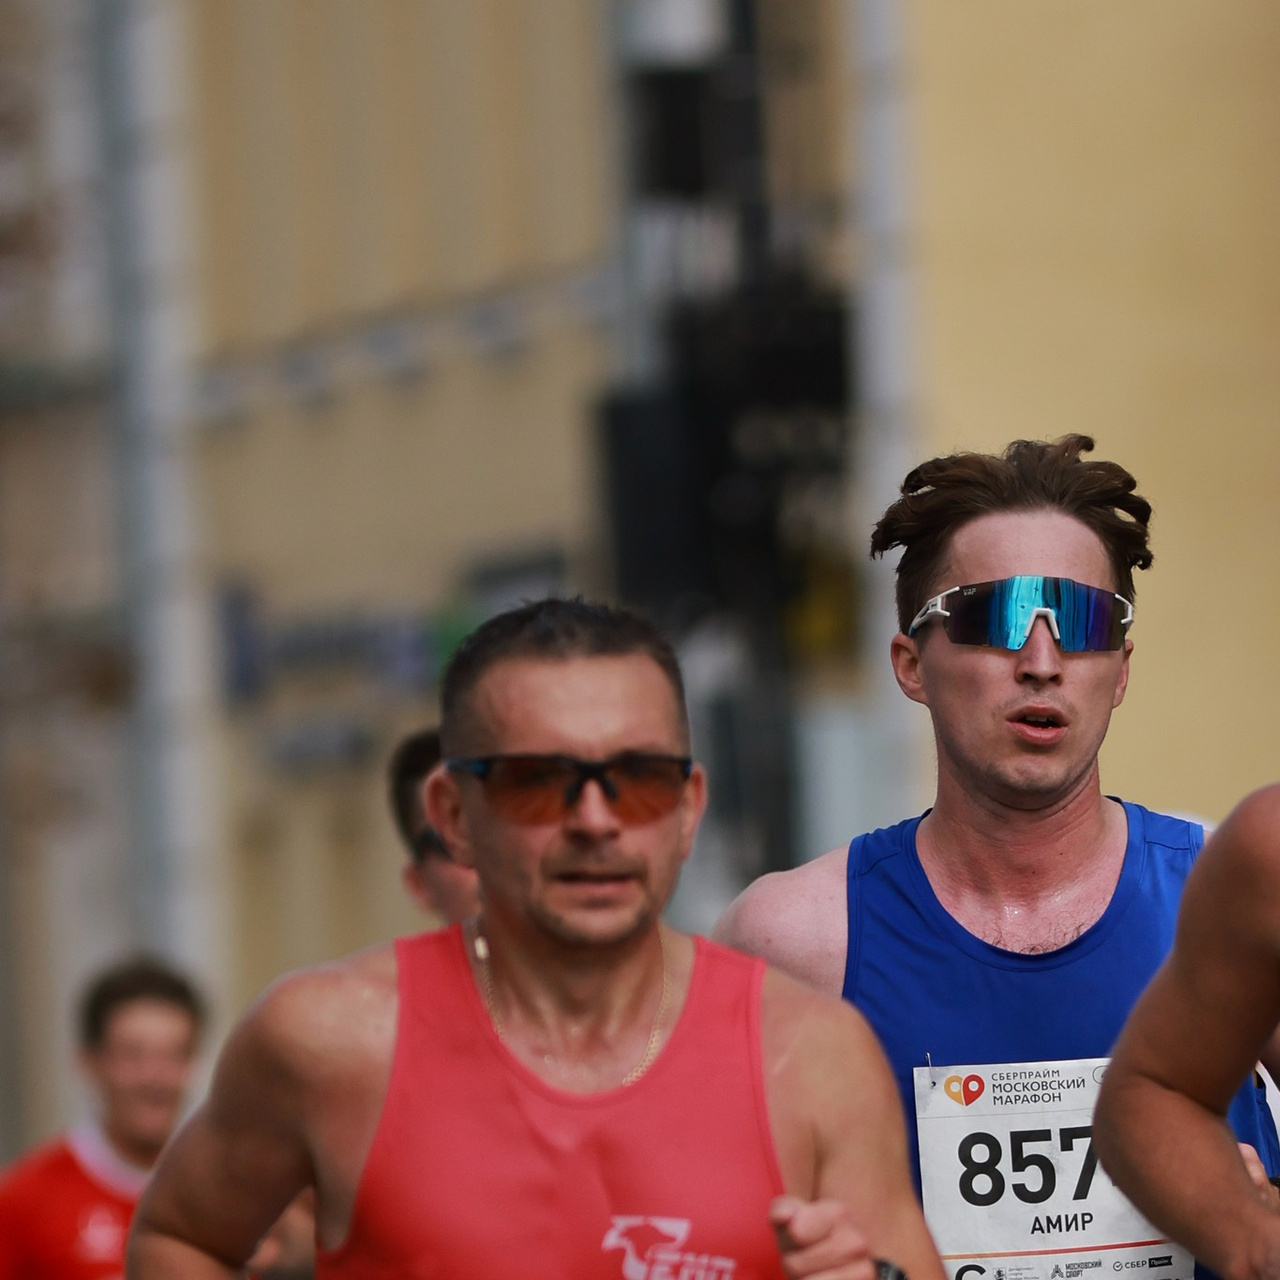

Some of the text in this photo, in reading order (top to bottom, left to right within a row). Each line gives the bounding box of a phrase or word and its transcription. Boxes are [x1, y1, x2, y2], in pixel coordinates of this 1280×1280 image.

[991, 1069, 1060, 1081] СБЕРПРАЙМ
[992, 1077, 1086, 1094] МОСКОВСКИЙ
[992, 1092, 1062, 1106] МАРАФОН
[957, 1124, 1116, 1207] 857
[1030, 1212, 1094, 1235] АМИР
[1124, 1260, 1148, 1269] СБЕР
